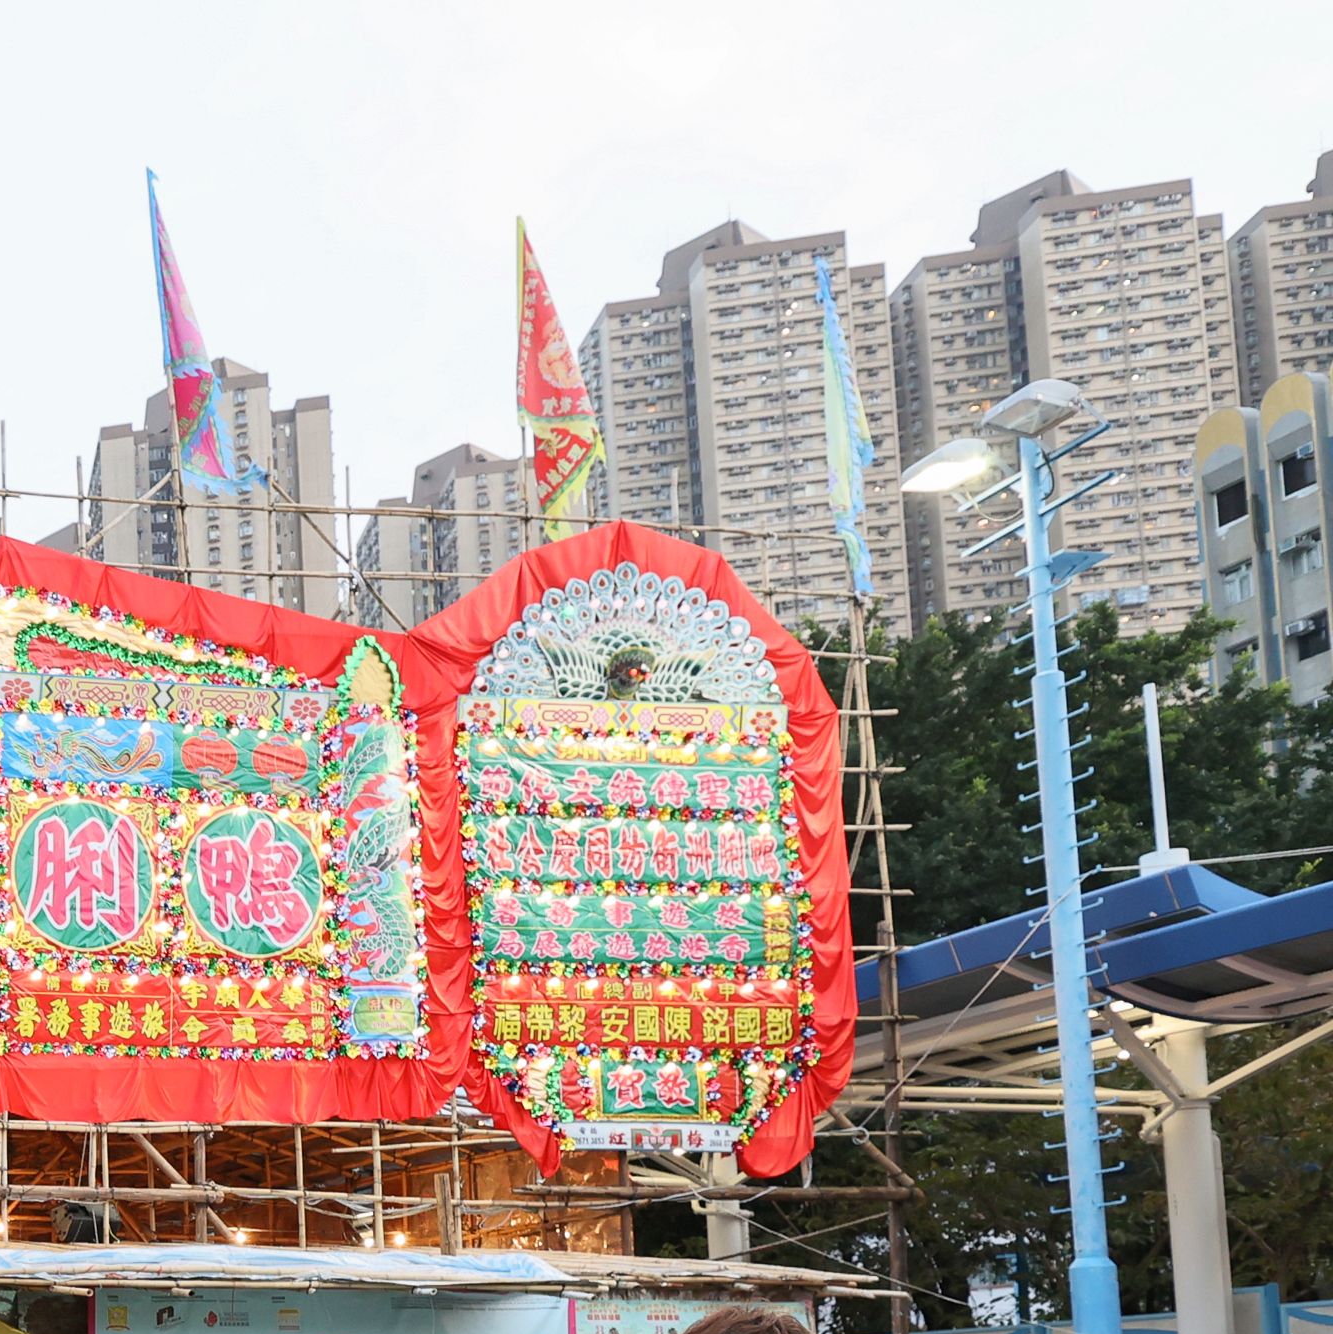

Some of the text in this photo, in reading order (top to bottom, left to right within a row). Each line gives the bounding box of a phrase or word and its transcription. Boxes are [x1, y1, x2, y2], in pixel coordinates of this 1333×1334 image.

[480, 766, 773, 810] 洪聖傳統文化節
[492, 930, 751, 962] 香港旅遊發展局
[13, 998, 167, 1040] 旅遊事務署
[180, 1015, 309, 1045] 委員會
[601, 1006, 693, 1044] 陳國安
[607, 1065, 691, 1109] 敬賀
